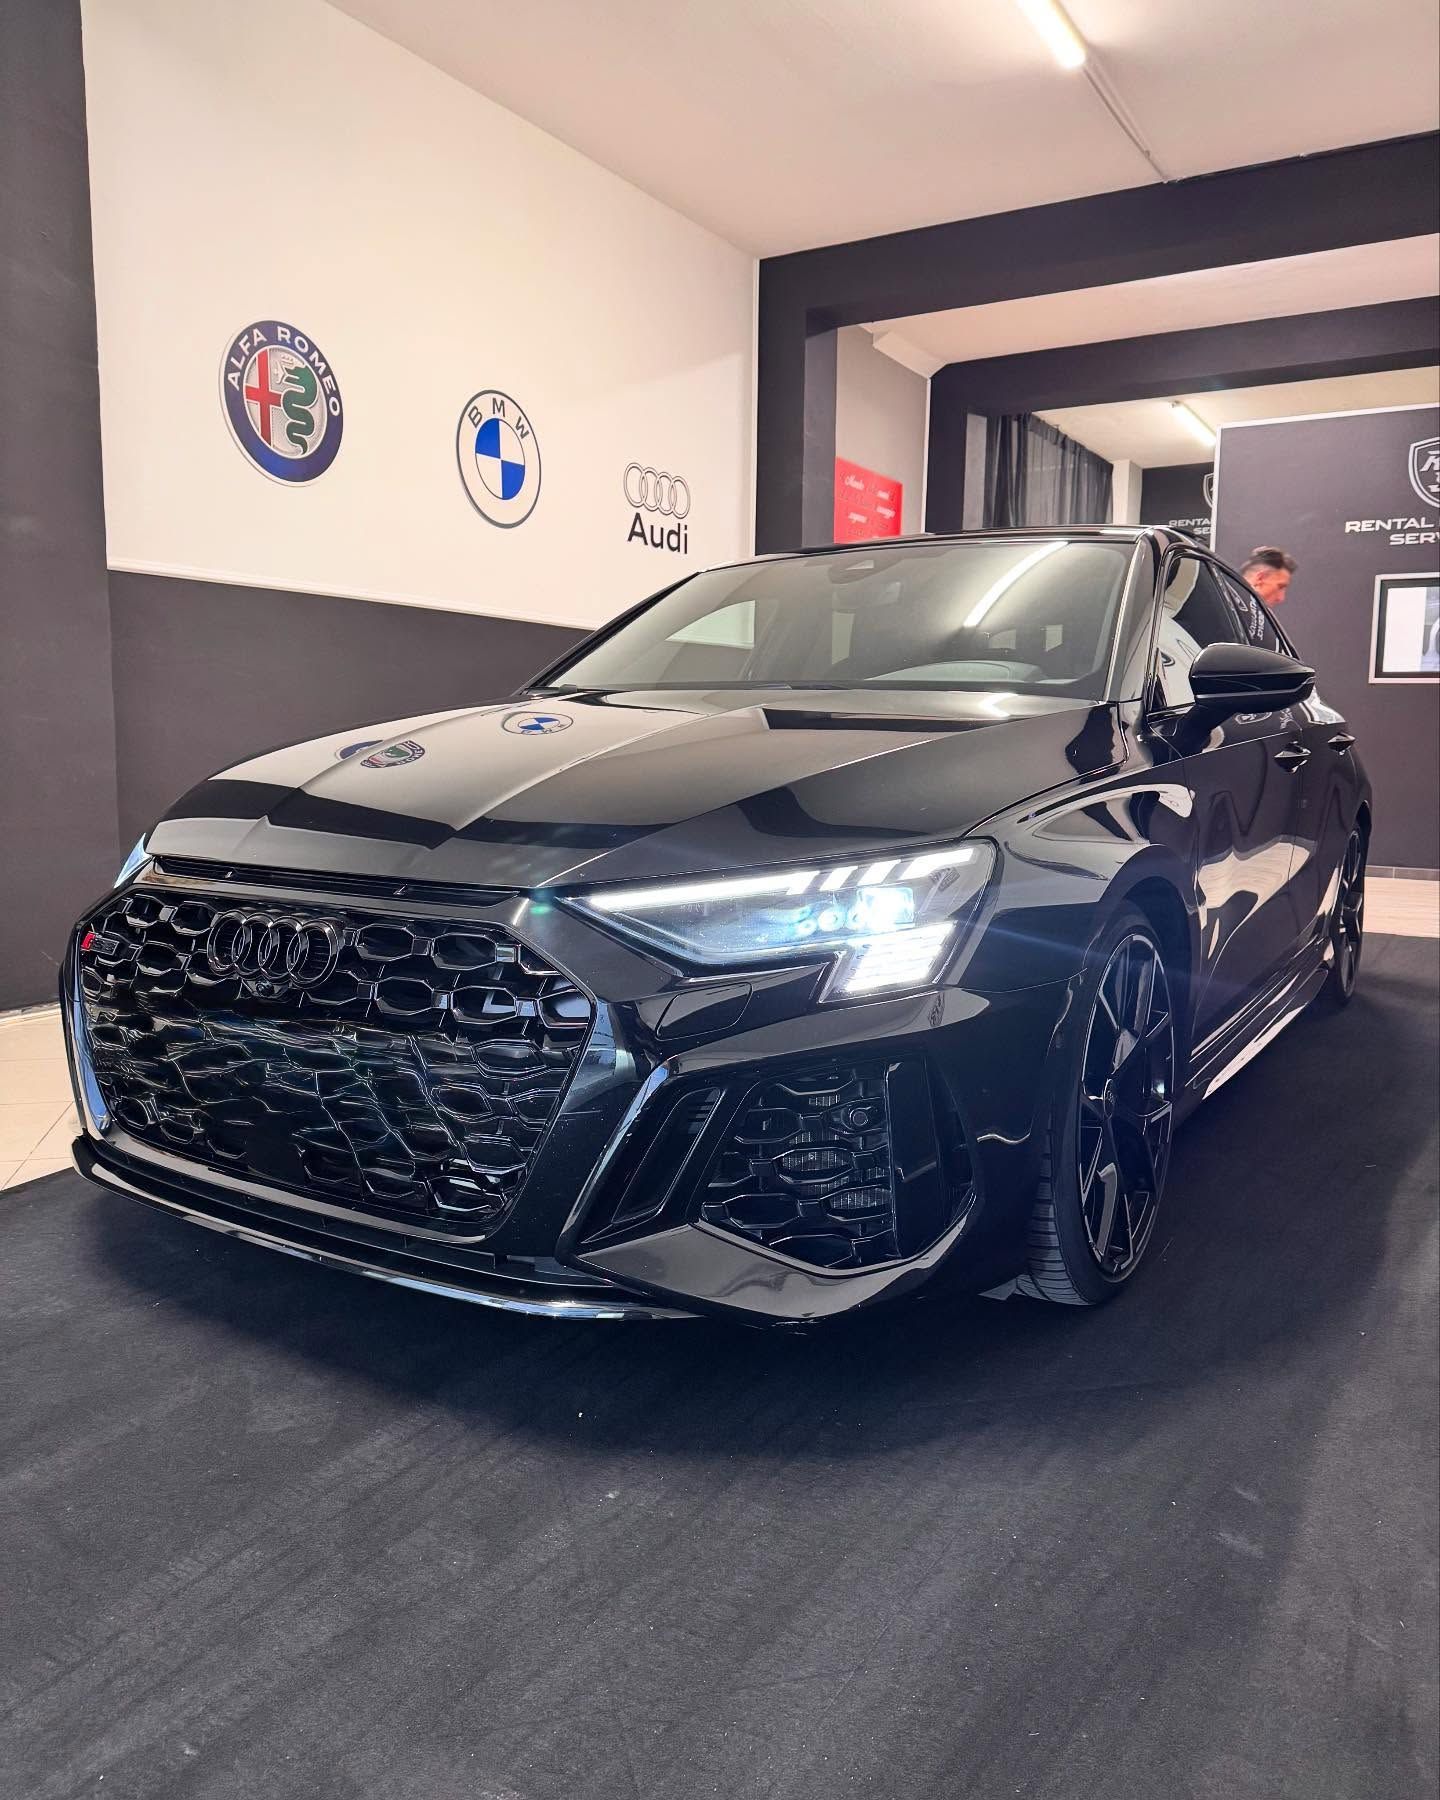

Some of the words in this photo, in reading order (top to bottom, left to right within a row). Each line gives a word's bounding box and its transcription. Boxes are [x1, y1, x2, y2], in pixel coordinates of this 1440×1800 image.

[227, 327, 268, 391] ALFA
[276, 326, 340, 417] ROMEO
[468, 397, 530, 440] BMW
[627, 512, 688, 555] Audi
[1169, 518, 1211, 527] RENTA
[1193, 526, 1211, 535] SE
[1344, 517, 1435, 533] RENTAL
